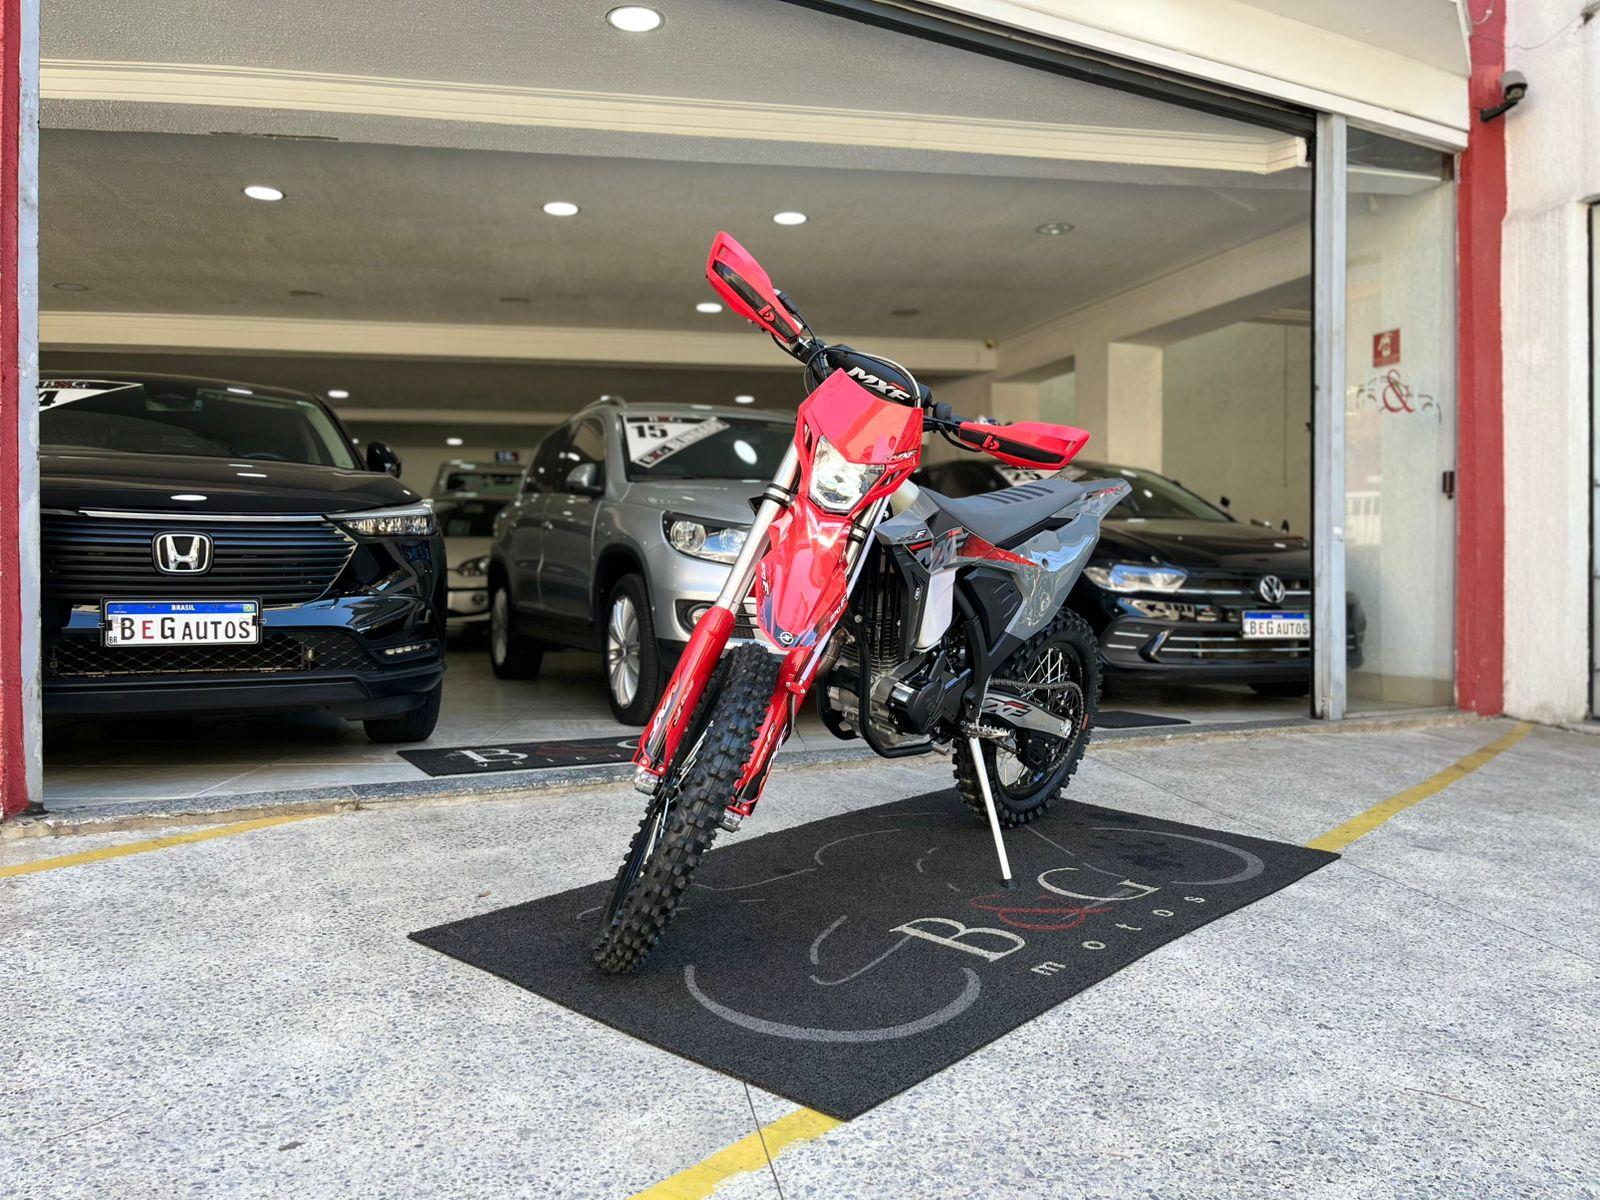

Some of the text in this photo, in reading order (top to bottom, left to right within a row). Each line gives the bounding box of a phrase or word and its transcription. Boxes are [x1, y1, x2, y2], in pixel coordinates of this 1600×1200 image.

[846, 366, 911, 400] MXF
[631, 424, 668, 438] 15
[1030, 896, 1206, 976] motos
